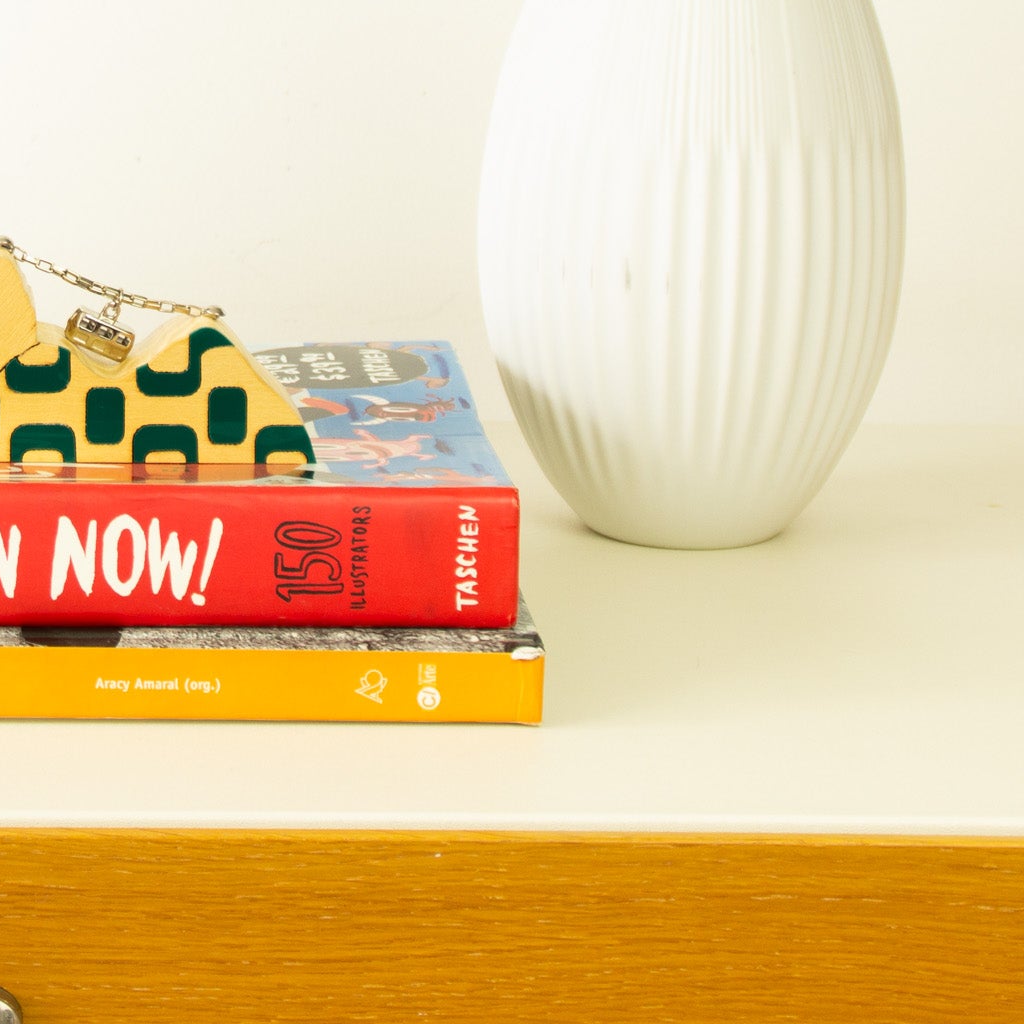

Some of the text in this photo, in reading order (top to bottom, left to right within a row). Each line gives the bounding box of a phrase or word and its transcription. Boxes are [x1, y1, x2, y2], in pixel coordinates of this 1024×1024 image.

[358, 348, 401, 384] TASCHEN
[50, 513, 224, 606] NOW!
[273, 520, 345, 603] 150
[349, 506, 372, 611] ILLUSTRATORS
[455, 504, 479, 612] TASCHEN
[95, 677, 221, 694] Aracy Amaral (org.)
